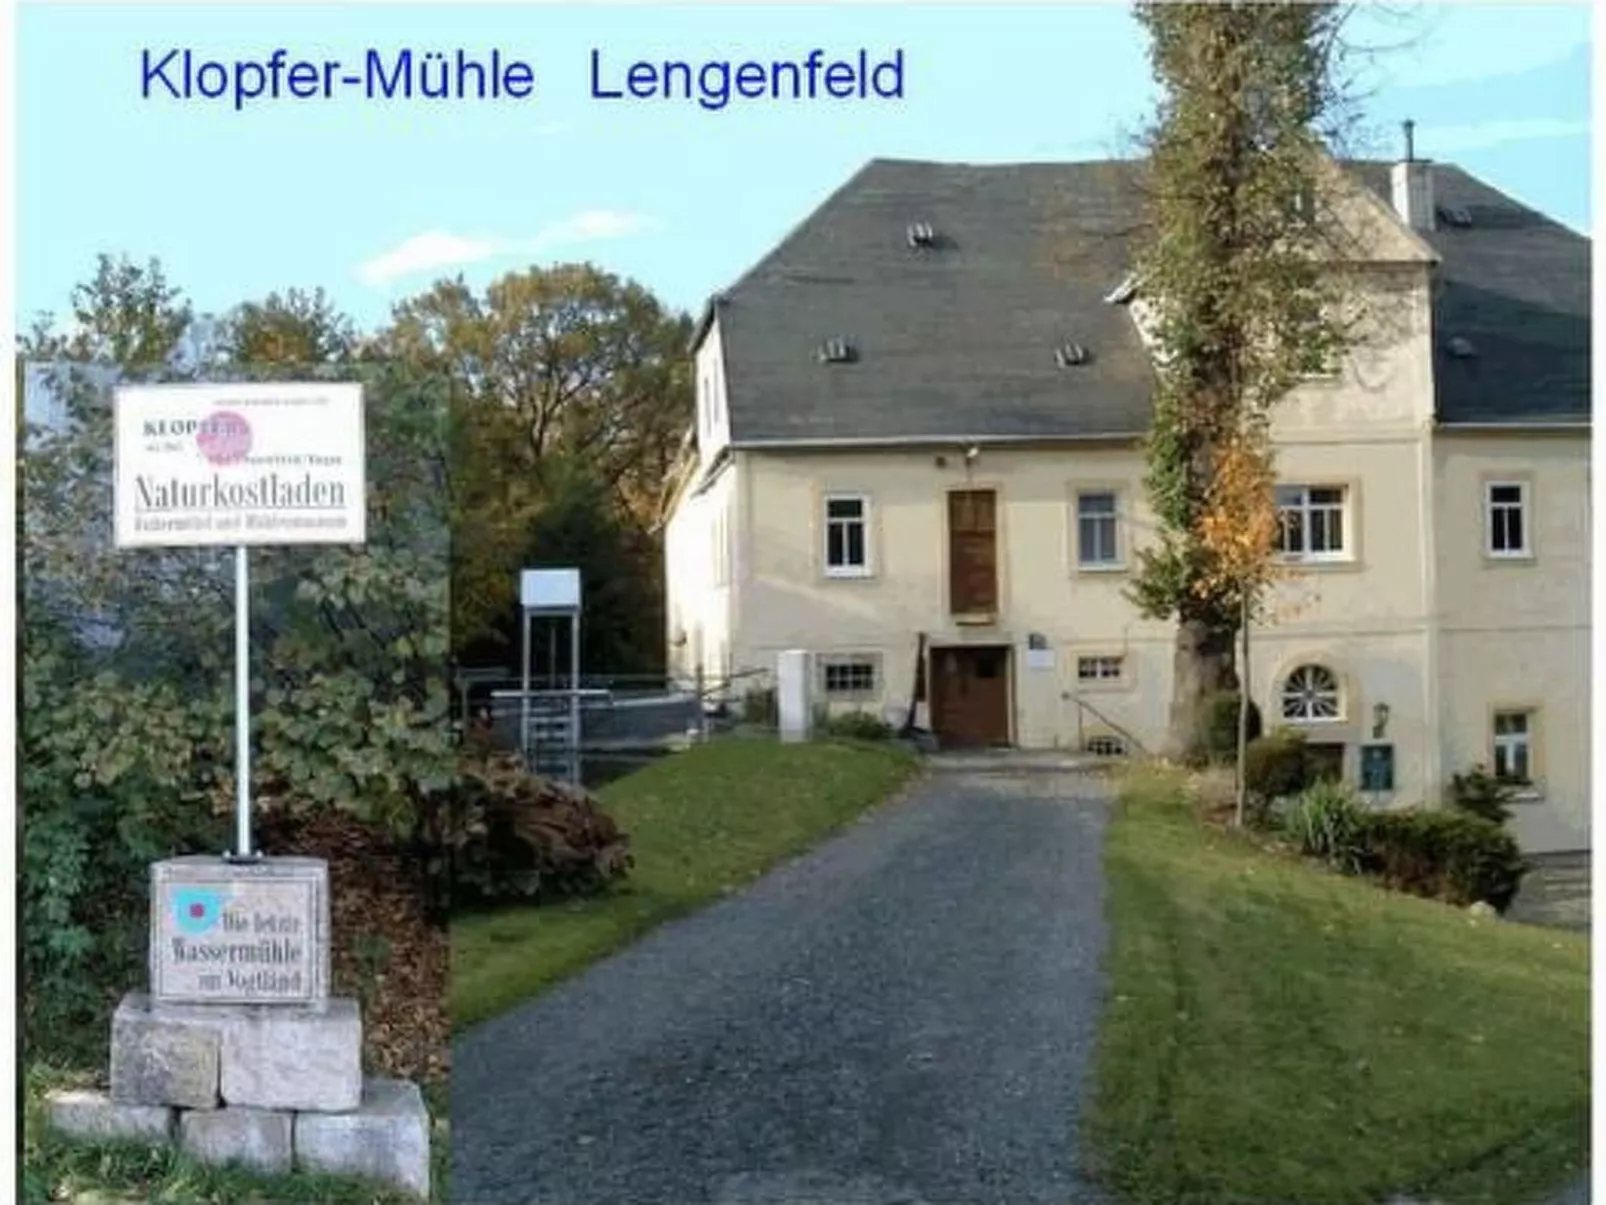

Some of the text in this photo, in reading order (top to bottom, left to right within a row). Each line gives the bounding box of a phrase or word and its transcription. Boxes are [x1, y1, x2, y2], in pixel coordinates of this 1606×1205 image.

[135, 472, 346, 507] Naturkostladen
[222, 910, 248, 932] Die
[172, 937, 302, 964] Wassermühle
